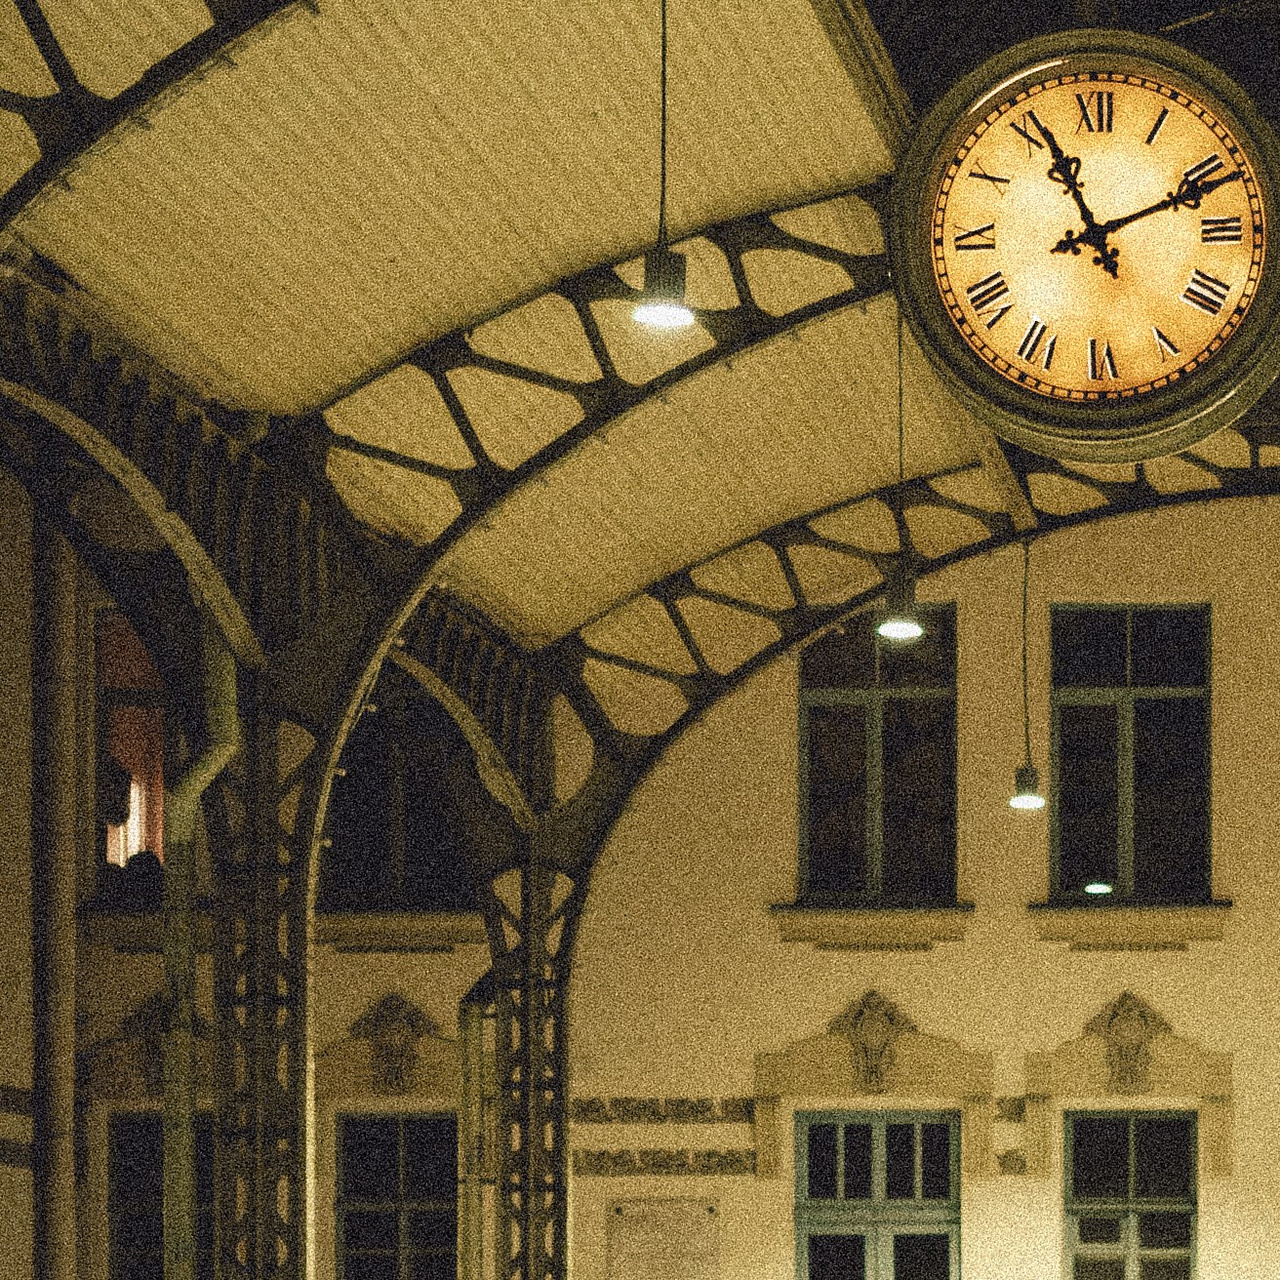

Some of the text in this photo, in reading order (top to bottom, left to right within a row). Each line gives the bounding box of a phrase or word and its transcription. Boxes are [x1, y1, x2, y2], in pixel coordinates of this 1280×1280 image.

[1074, 91, 1113, 135] XII
[1145, 106, 1169, 145] I
[968, 158, 1011, 197] X
[1183, 153, 1225, 182] II
[954, 220, 996, 251] IX
[1201, 216, 1242, 243] III
[967, 271, 1015, 330] VIII
[1182, 268, 1231, 316] IIII
[1017, 320, 1058, 370] VII
[1088, 337, 1120, 380] VI
[1152, 326, 1182, 363] V
